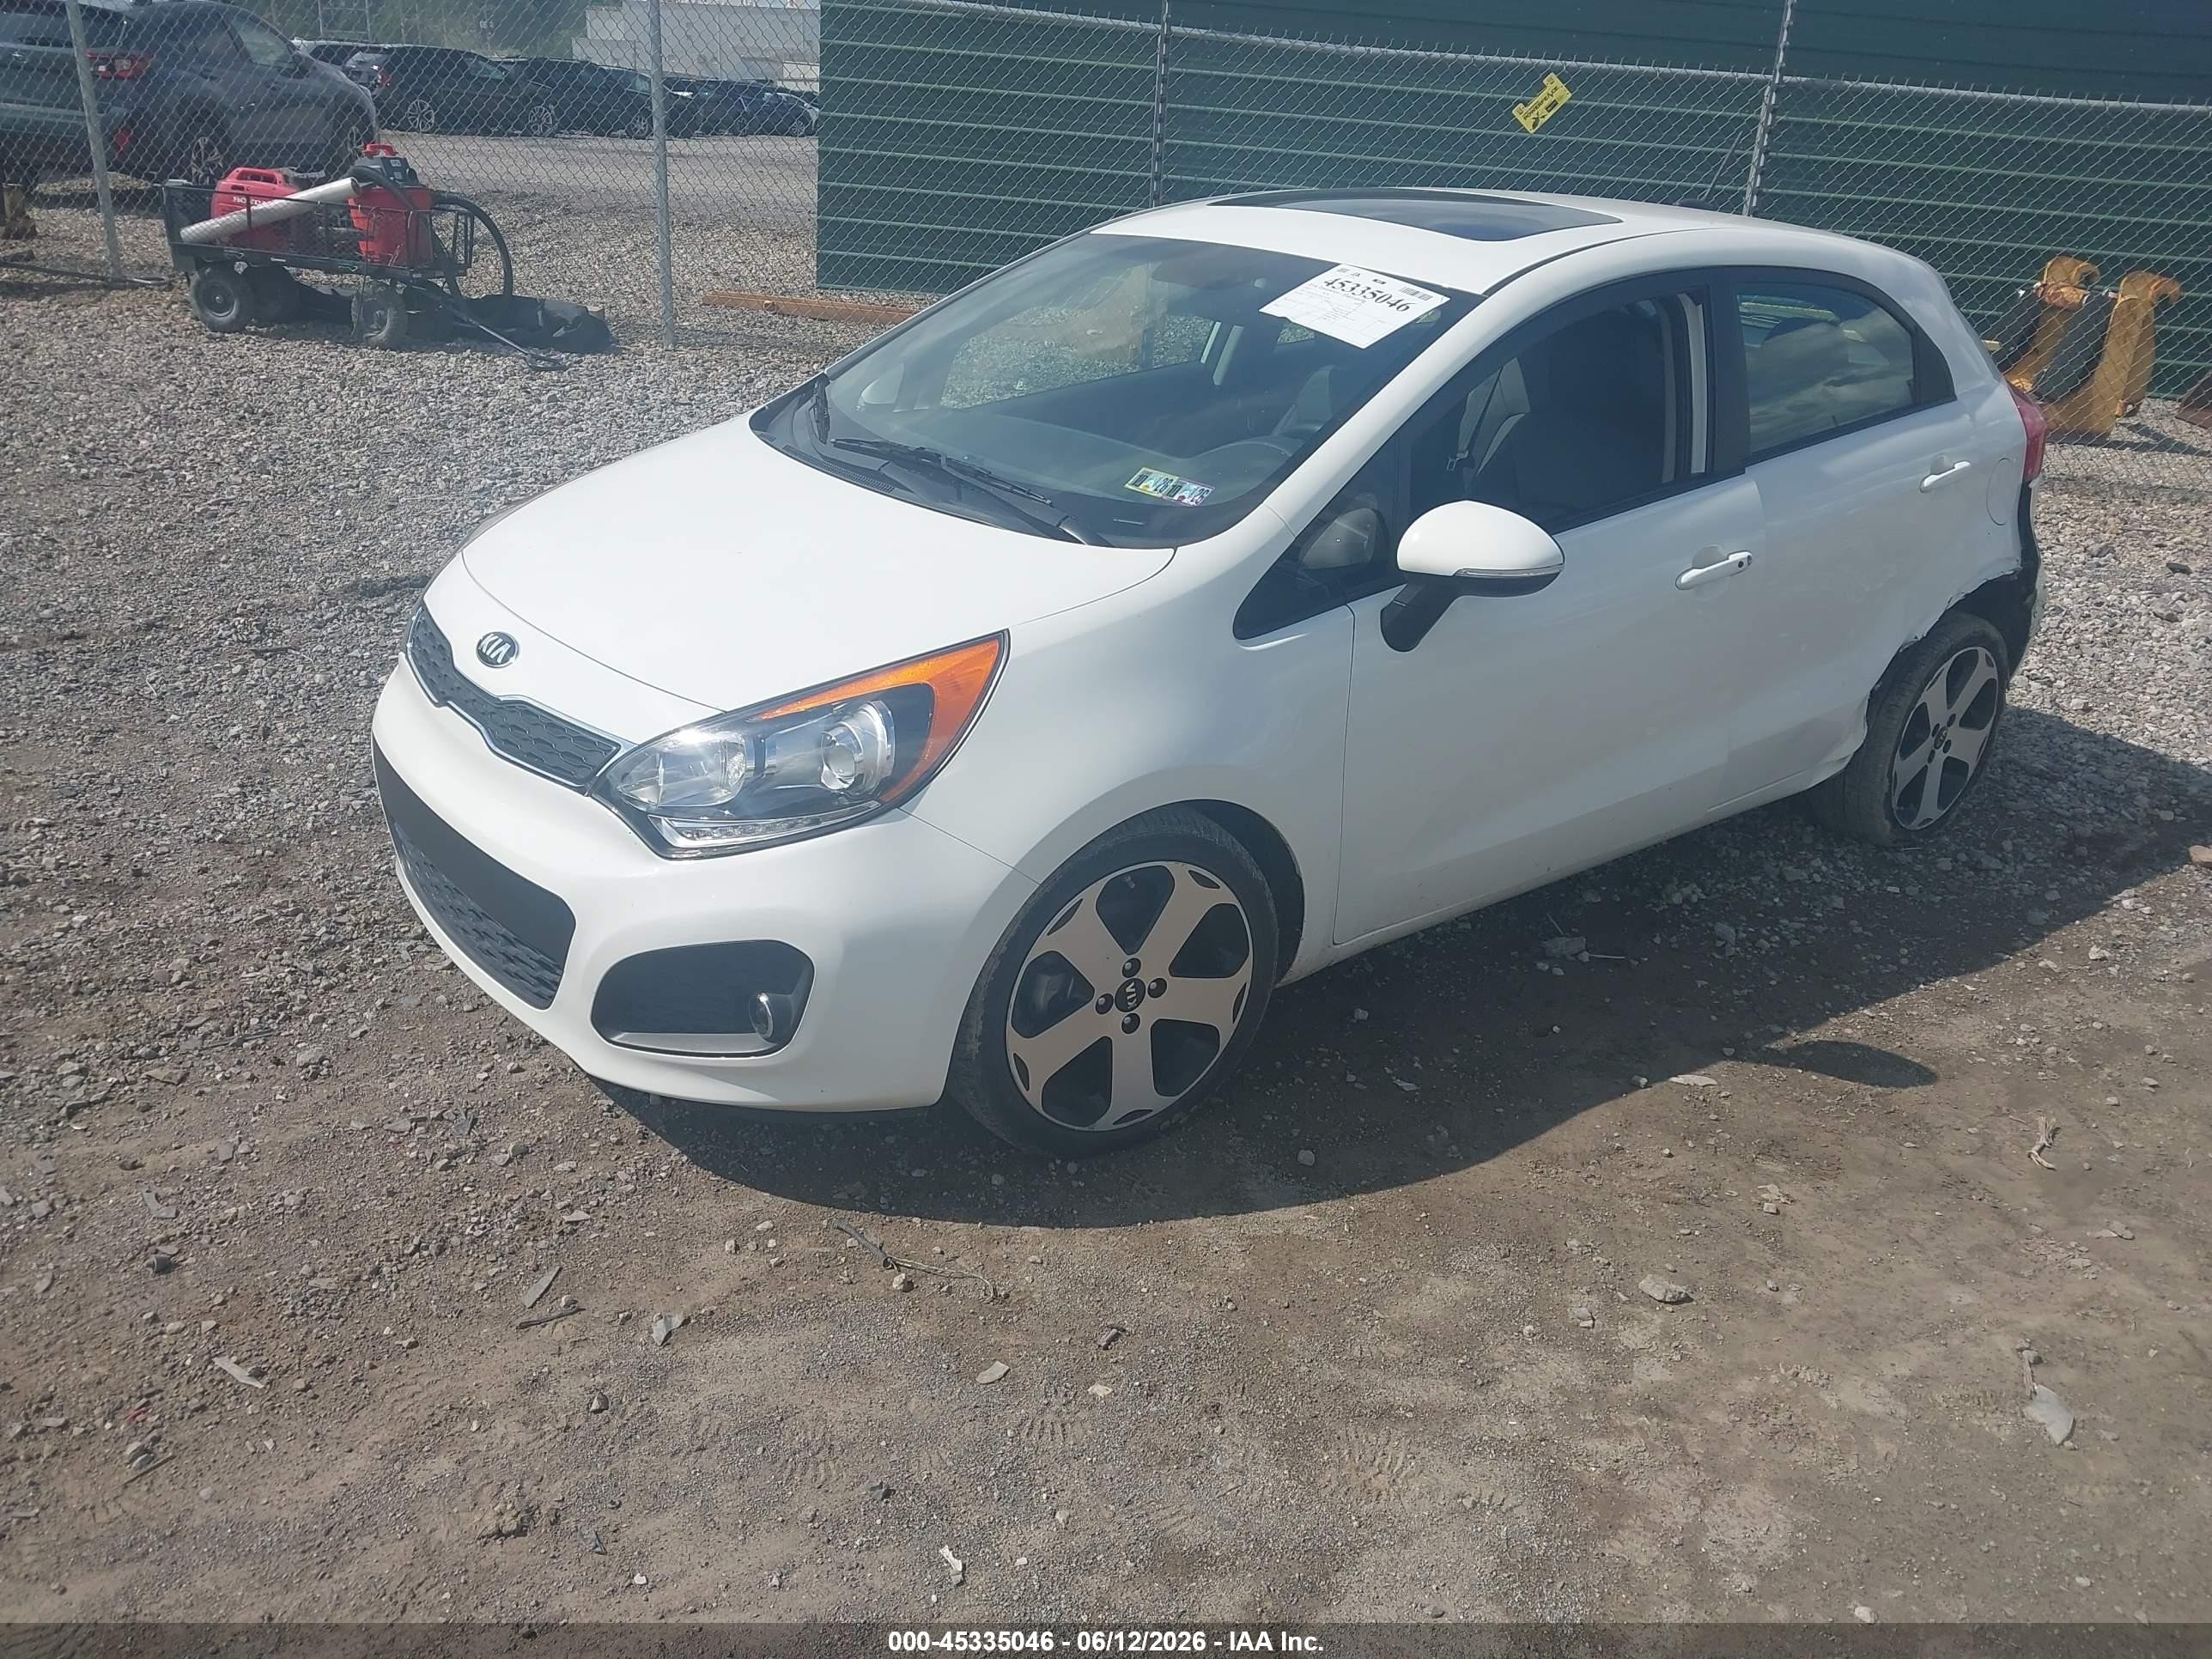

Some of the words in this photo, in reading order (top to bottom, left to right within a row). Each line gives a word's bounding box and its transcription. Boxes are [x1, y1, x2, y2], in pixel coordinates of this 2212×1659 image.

[1323, 277, 1415, 313] 45335046
[477, 633, 512, 664] KIA
[1126, 981, 1137, 1009] KIA
